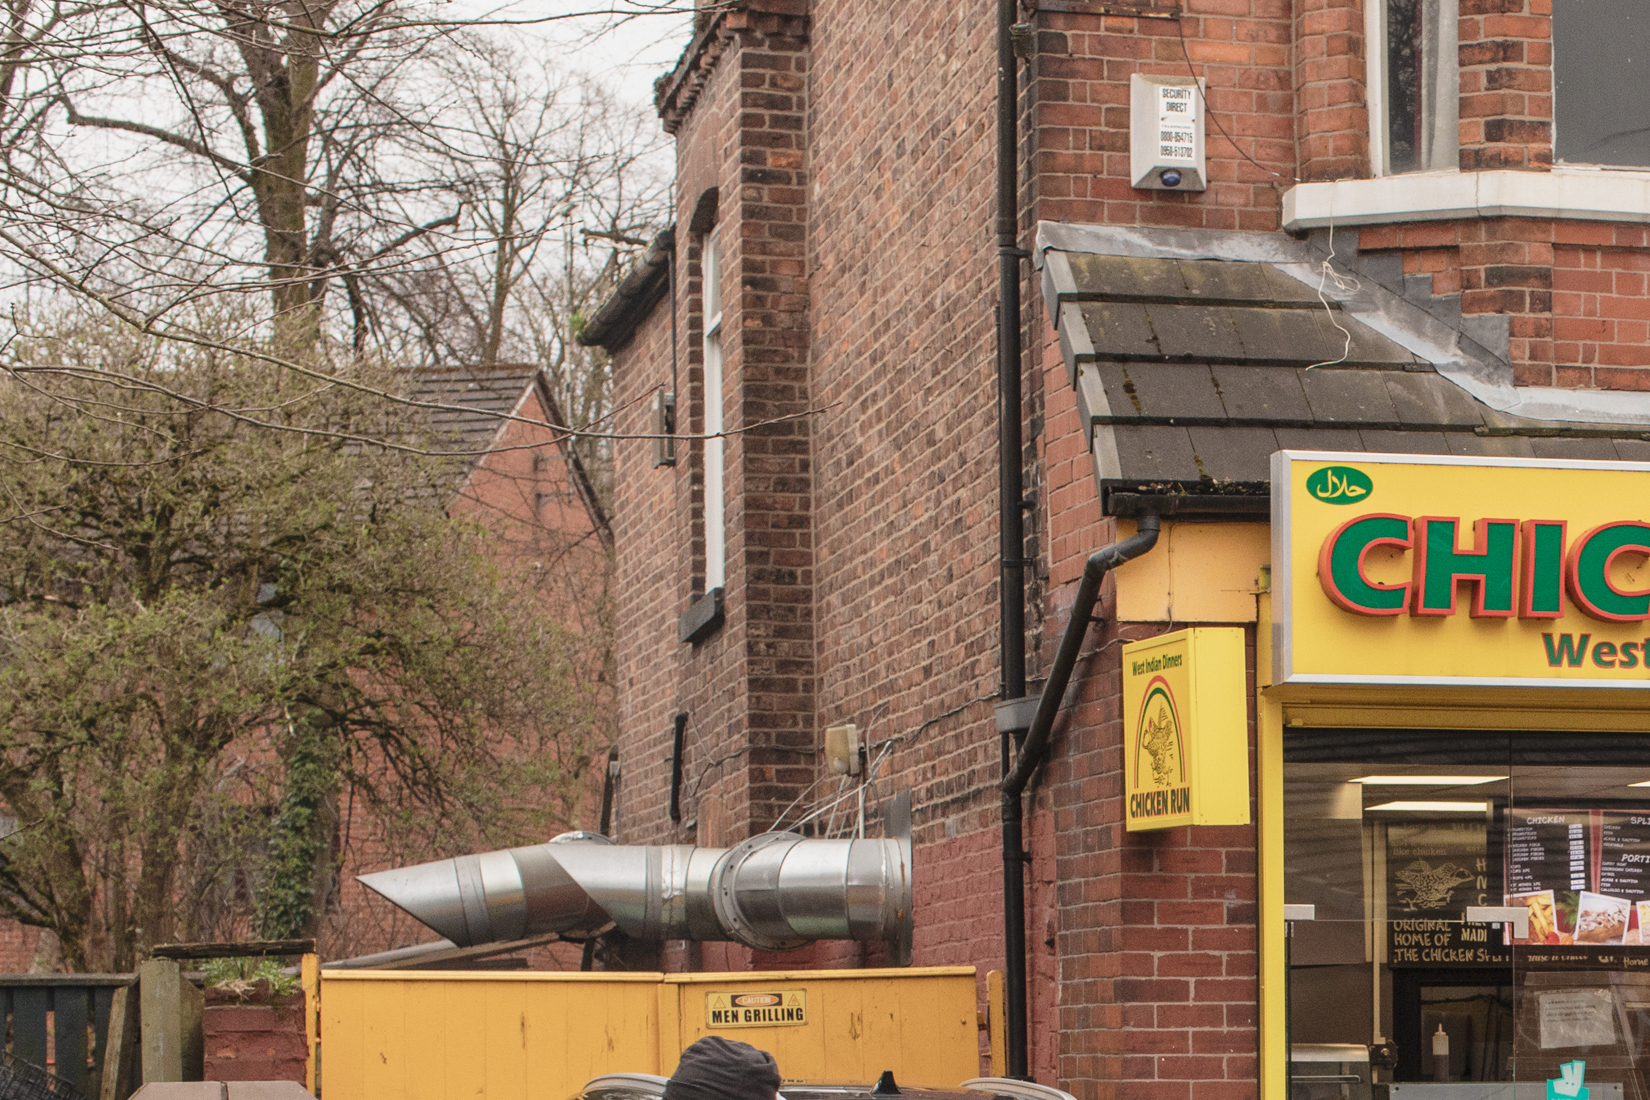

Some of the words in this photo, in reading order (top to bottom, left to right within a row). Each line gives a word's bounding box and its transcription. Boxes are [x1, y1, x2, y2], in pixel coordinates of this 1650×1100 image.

[1162, 88, 1191, 100] SECURITY
[1166, 102, 1187, 113] DIRECT
[1316, 469, 1366, 498] حلال
[1132, 661, 1145, 676] West
[1146, 658, 1162, 674] Indian
[1162, 653, 1183, 669] Dinners
[1130, 790, 1169, 819] CHICKEN
[1170, 787, 1190, 815] RUN
[1526, 816, 1566, 825] CHICKEN
[1393, 918, 1452, 932] ORIGINAL
[1394, 932, 1431, 946] HOME
[1434, 932, 1452, 946] OF
[1394, 948, 1419, 962] THE
[1422, 948, 1474, 962] CHICKEN
[1622, 956, 1650, 968] Home
[742, 996, 772, 1004] CAUTION
[712, 1010, 739, 1024] MEN
[744, 1008, 804, 1022] GRILLING
